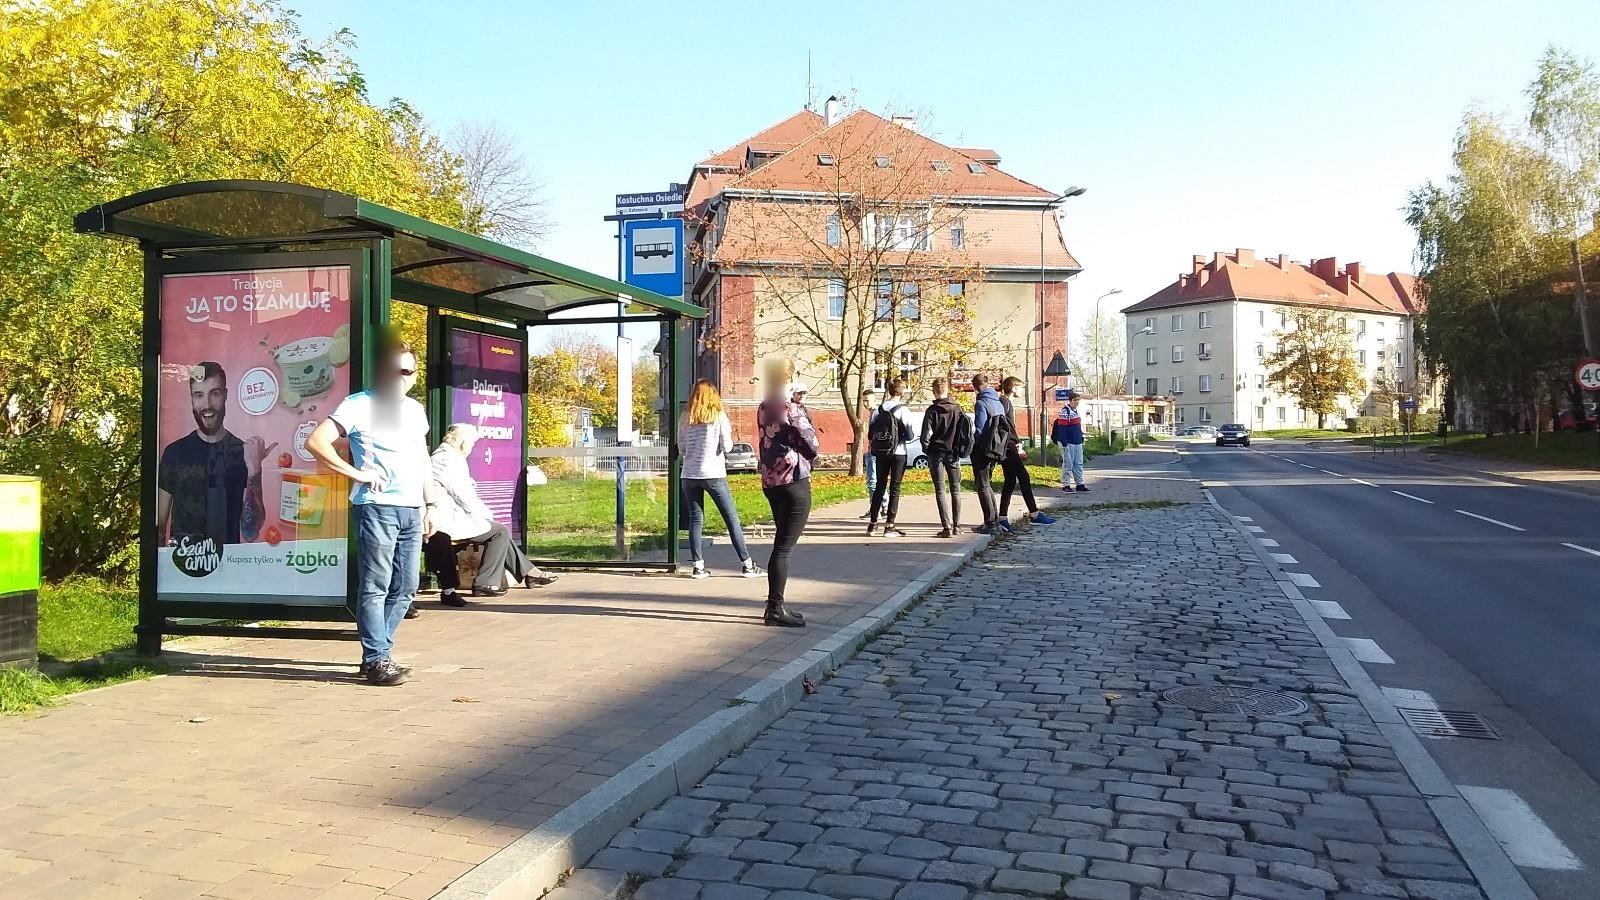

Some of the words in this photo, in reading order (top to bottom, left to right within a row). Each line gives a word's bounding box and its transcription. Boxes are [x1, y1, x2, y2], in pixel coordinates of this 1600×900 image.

[617, 195, 654, 204] Kostuchna
[656, 193, 683, 202] Osiedle
[232, 277, 284, 292] Tradycja
[186, 297, 210, 314] JA
[213, 296, 238, 313] TO
[242, 291, 331, 313] SZAMUJĘ
[246, 382, 265, 394] BEZ
[472, 379, 503, 400] Polacy
[177, 535, 216, 557] Szam
[185, 552, 219, 572] amm
[226, 554, 252, 565] Kupisz
[254, 554, 274, 564] tylko
[286, 550, 338, 567] żabka
